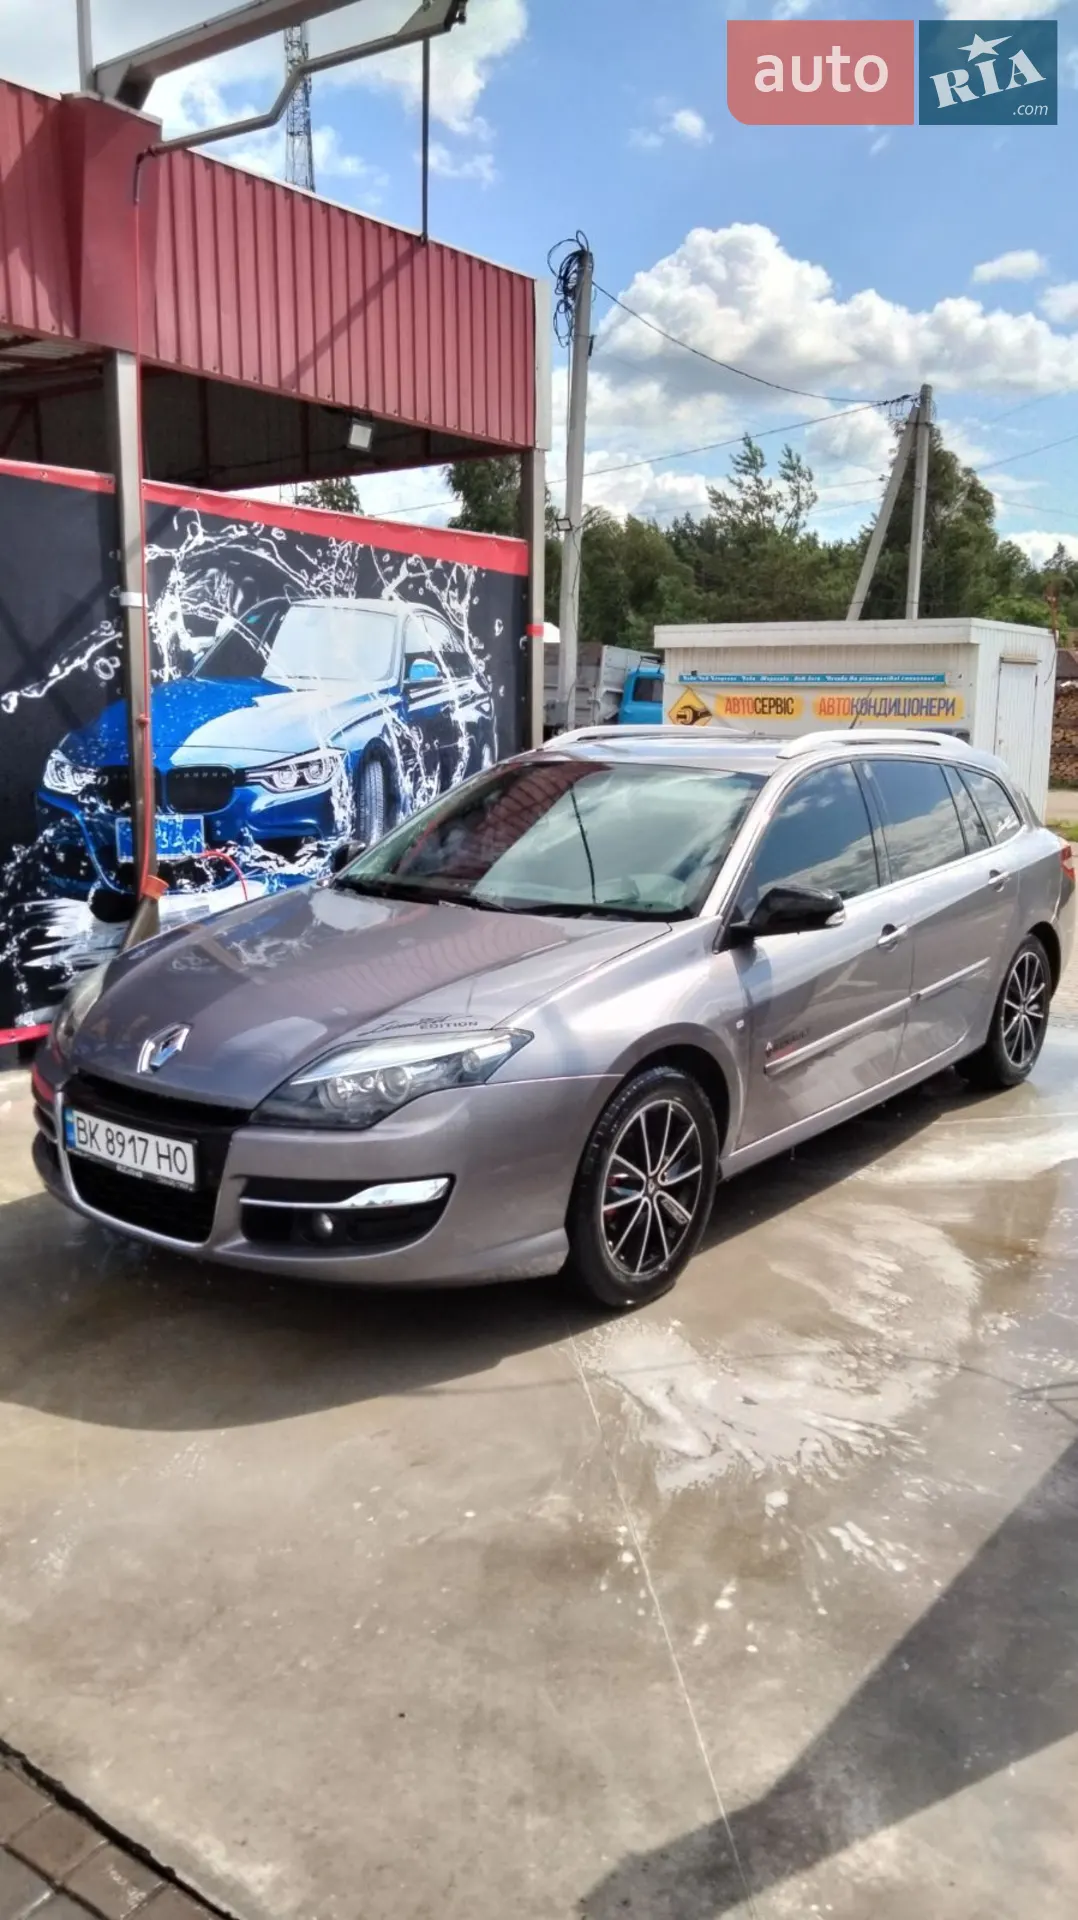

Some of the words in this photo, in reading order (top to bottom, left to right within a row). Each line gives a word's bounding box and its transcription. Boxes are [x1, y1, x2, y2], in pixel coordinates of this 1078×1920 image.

[725, 696, 794, 715] АВТОСЕРВІС
[818, 697, 956, 719] АВТОКОНДИЦІОНЕРИ
[76, 1116, 101, 1152] BK
[105, 1127, 149, 1166] 8917
[155, 1140, 188, 1175] HO
